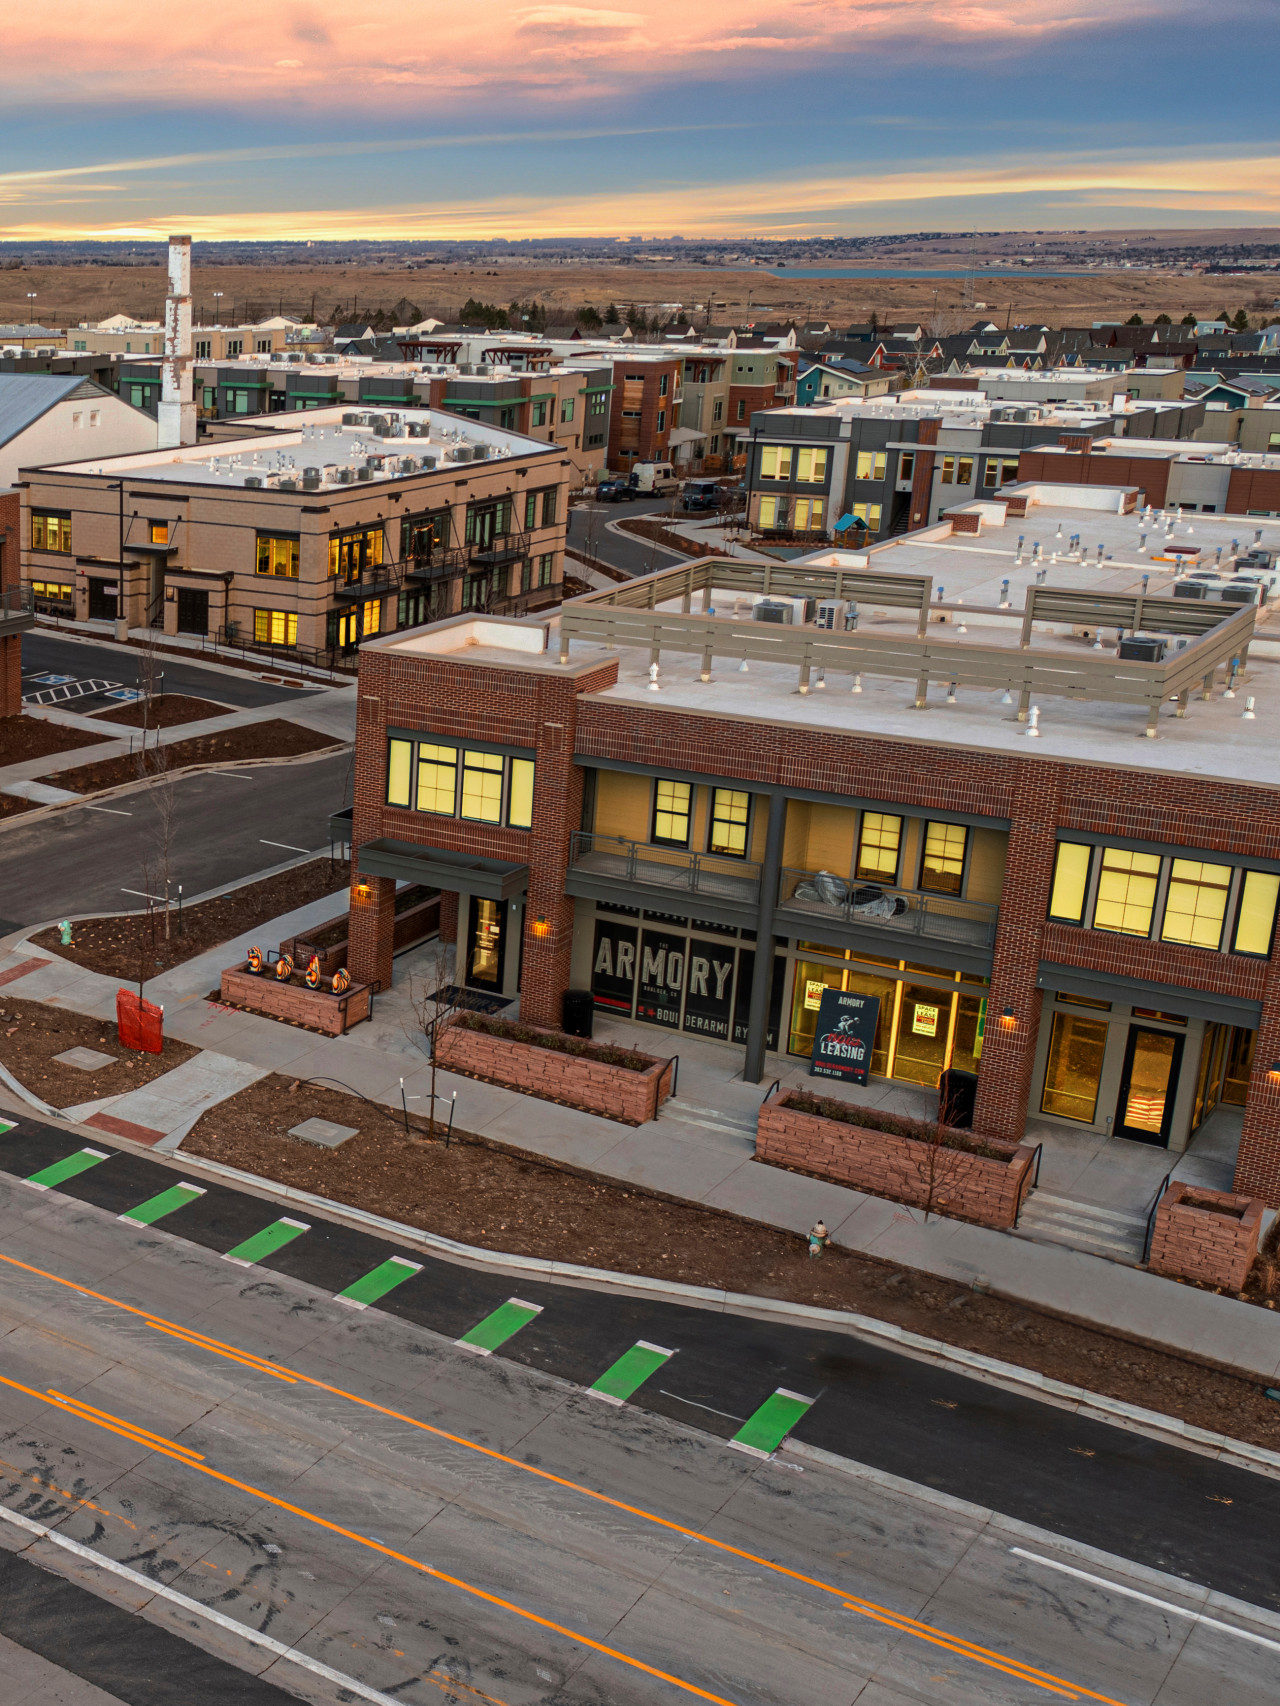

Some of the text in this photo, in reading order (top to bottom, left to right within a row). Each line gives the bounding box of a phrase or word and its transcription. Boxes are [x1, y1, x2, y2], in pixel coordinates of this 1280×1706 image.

[594, 936, 732, 1000] ARMORY
[838, 996, 864, 1008] ARMORY
[916, 1010, 936, 1018] LEASE
[917, 1005, 936, 1013] SPACE
[820, 1041, 865, 1061] LEASING
